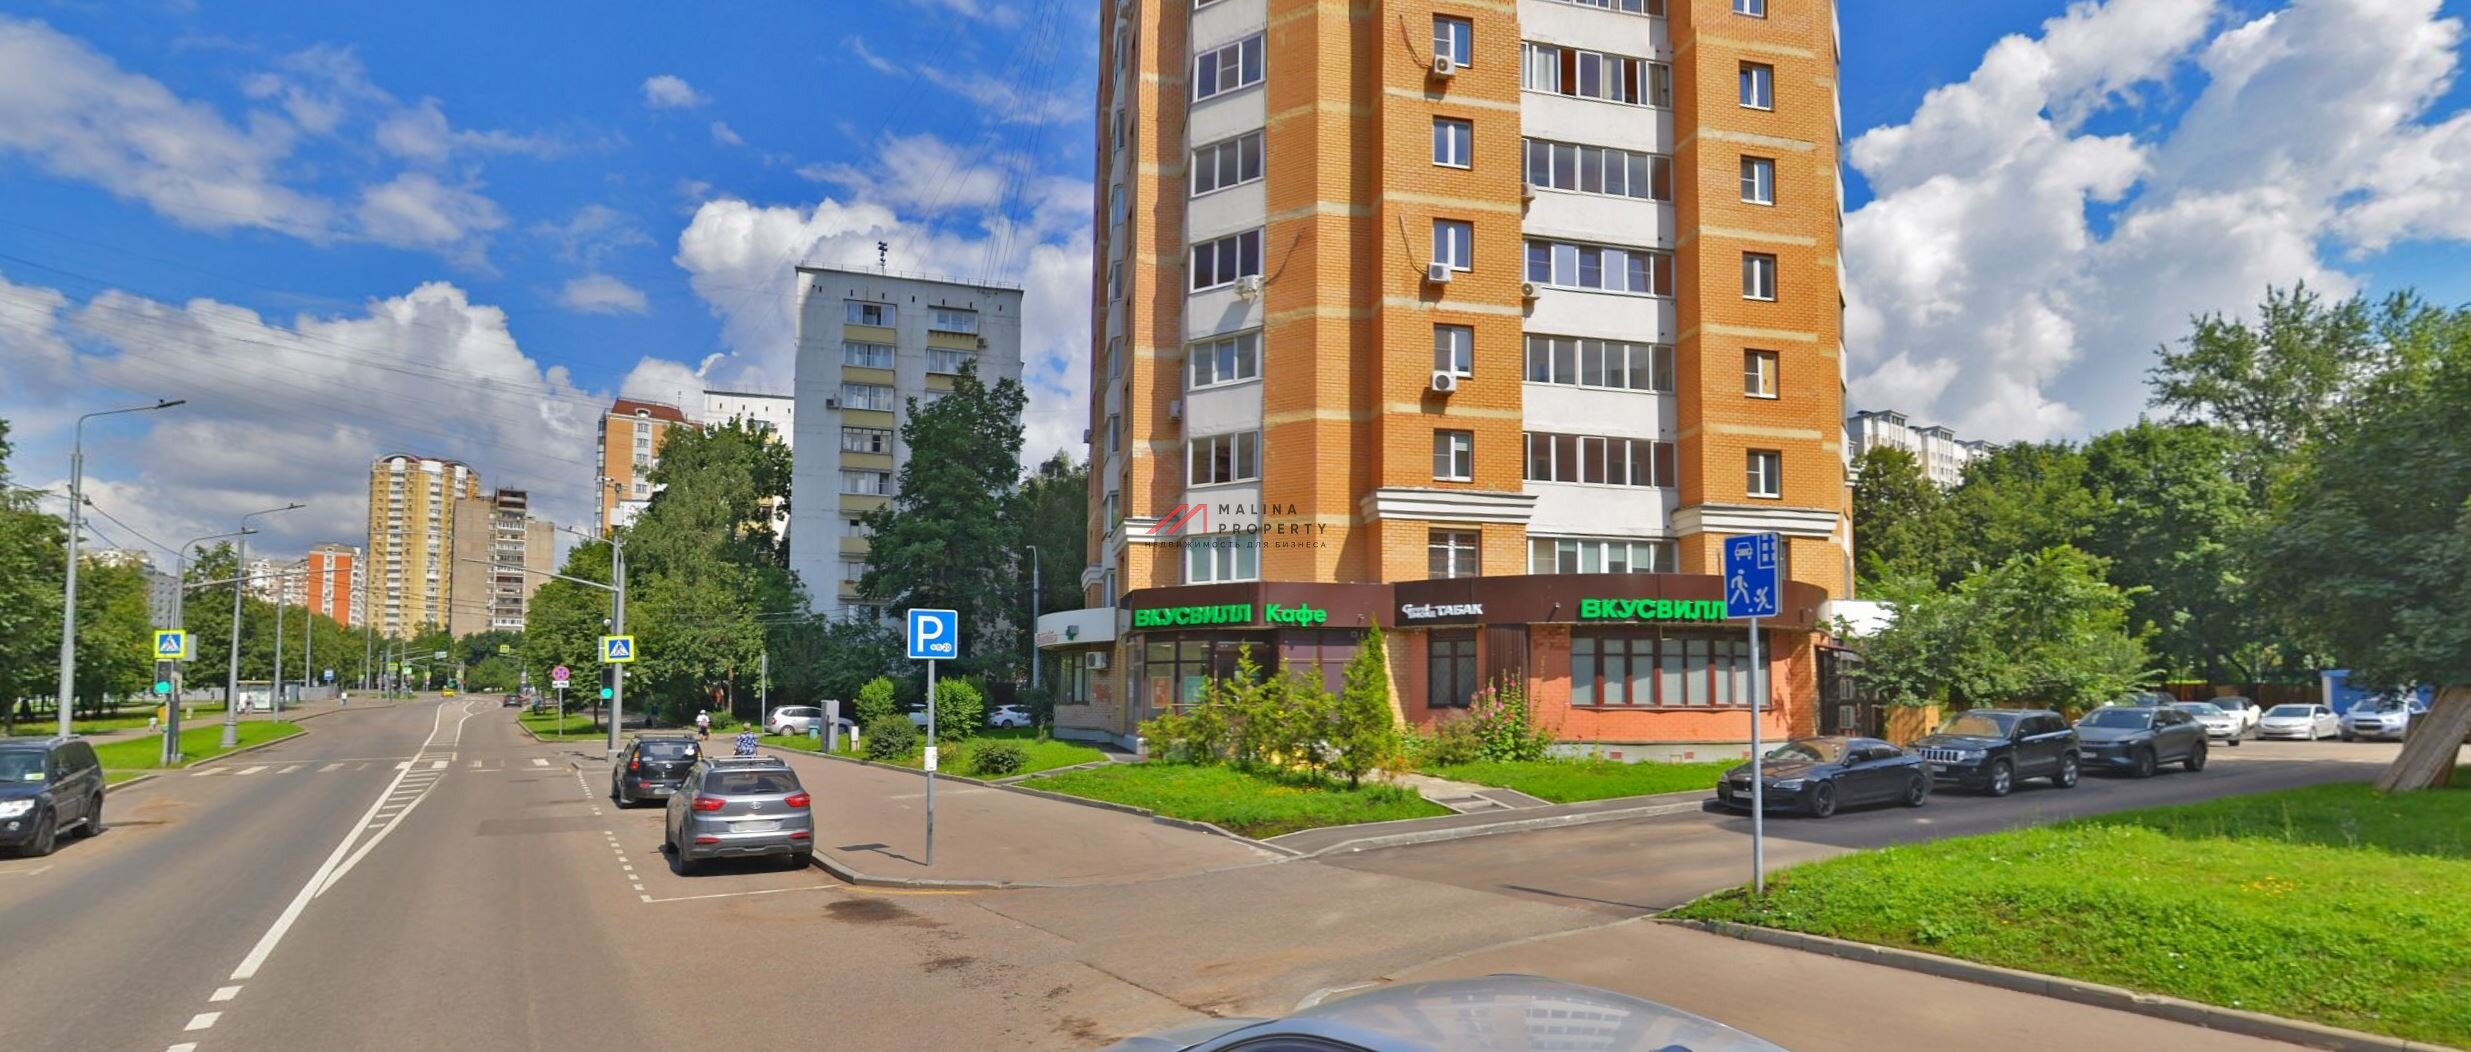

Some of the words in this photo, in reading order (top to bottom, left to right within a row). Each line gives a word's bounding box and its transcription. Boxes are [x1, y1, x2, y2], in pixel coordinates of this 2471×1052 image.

[1135, 604, 1251, 627] ВКУСВИЛЛ
[1266, 603, 1327, 627] Кафе
[1436, 603, 1483, 616] ТАБАК
[1580, 598, 1726, 619] ВКУСВИЛЛ
[917, 615, 943, 652] P
